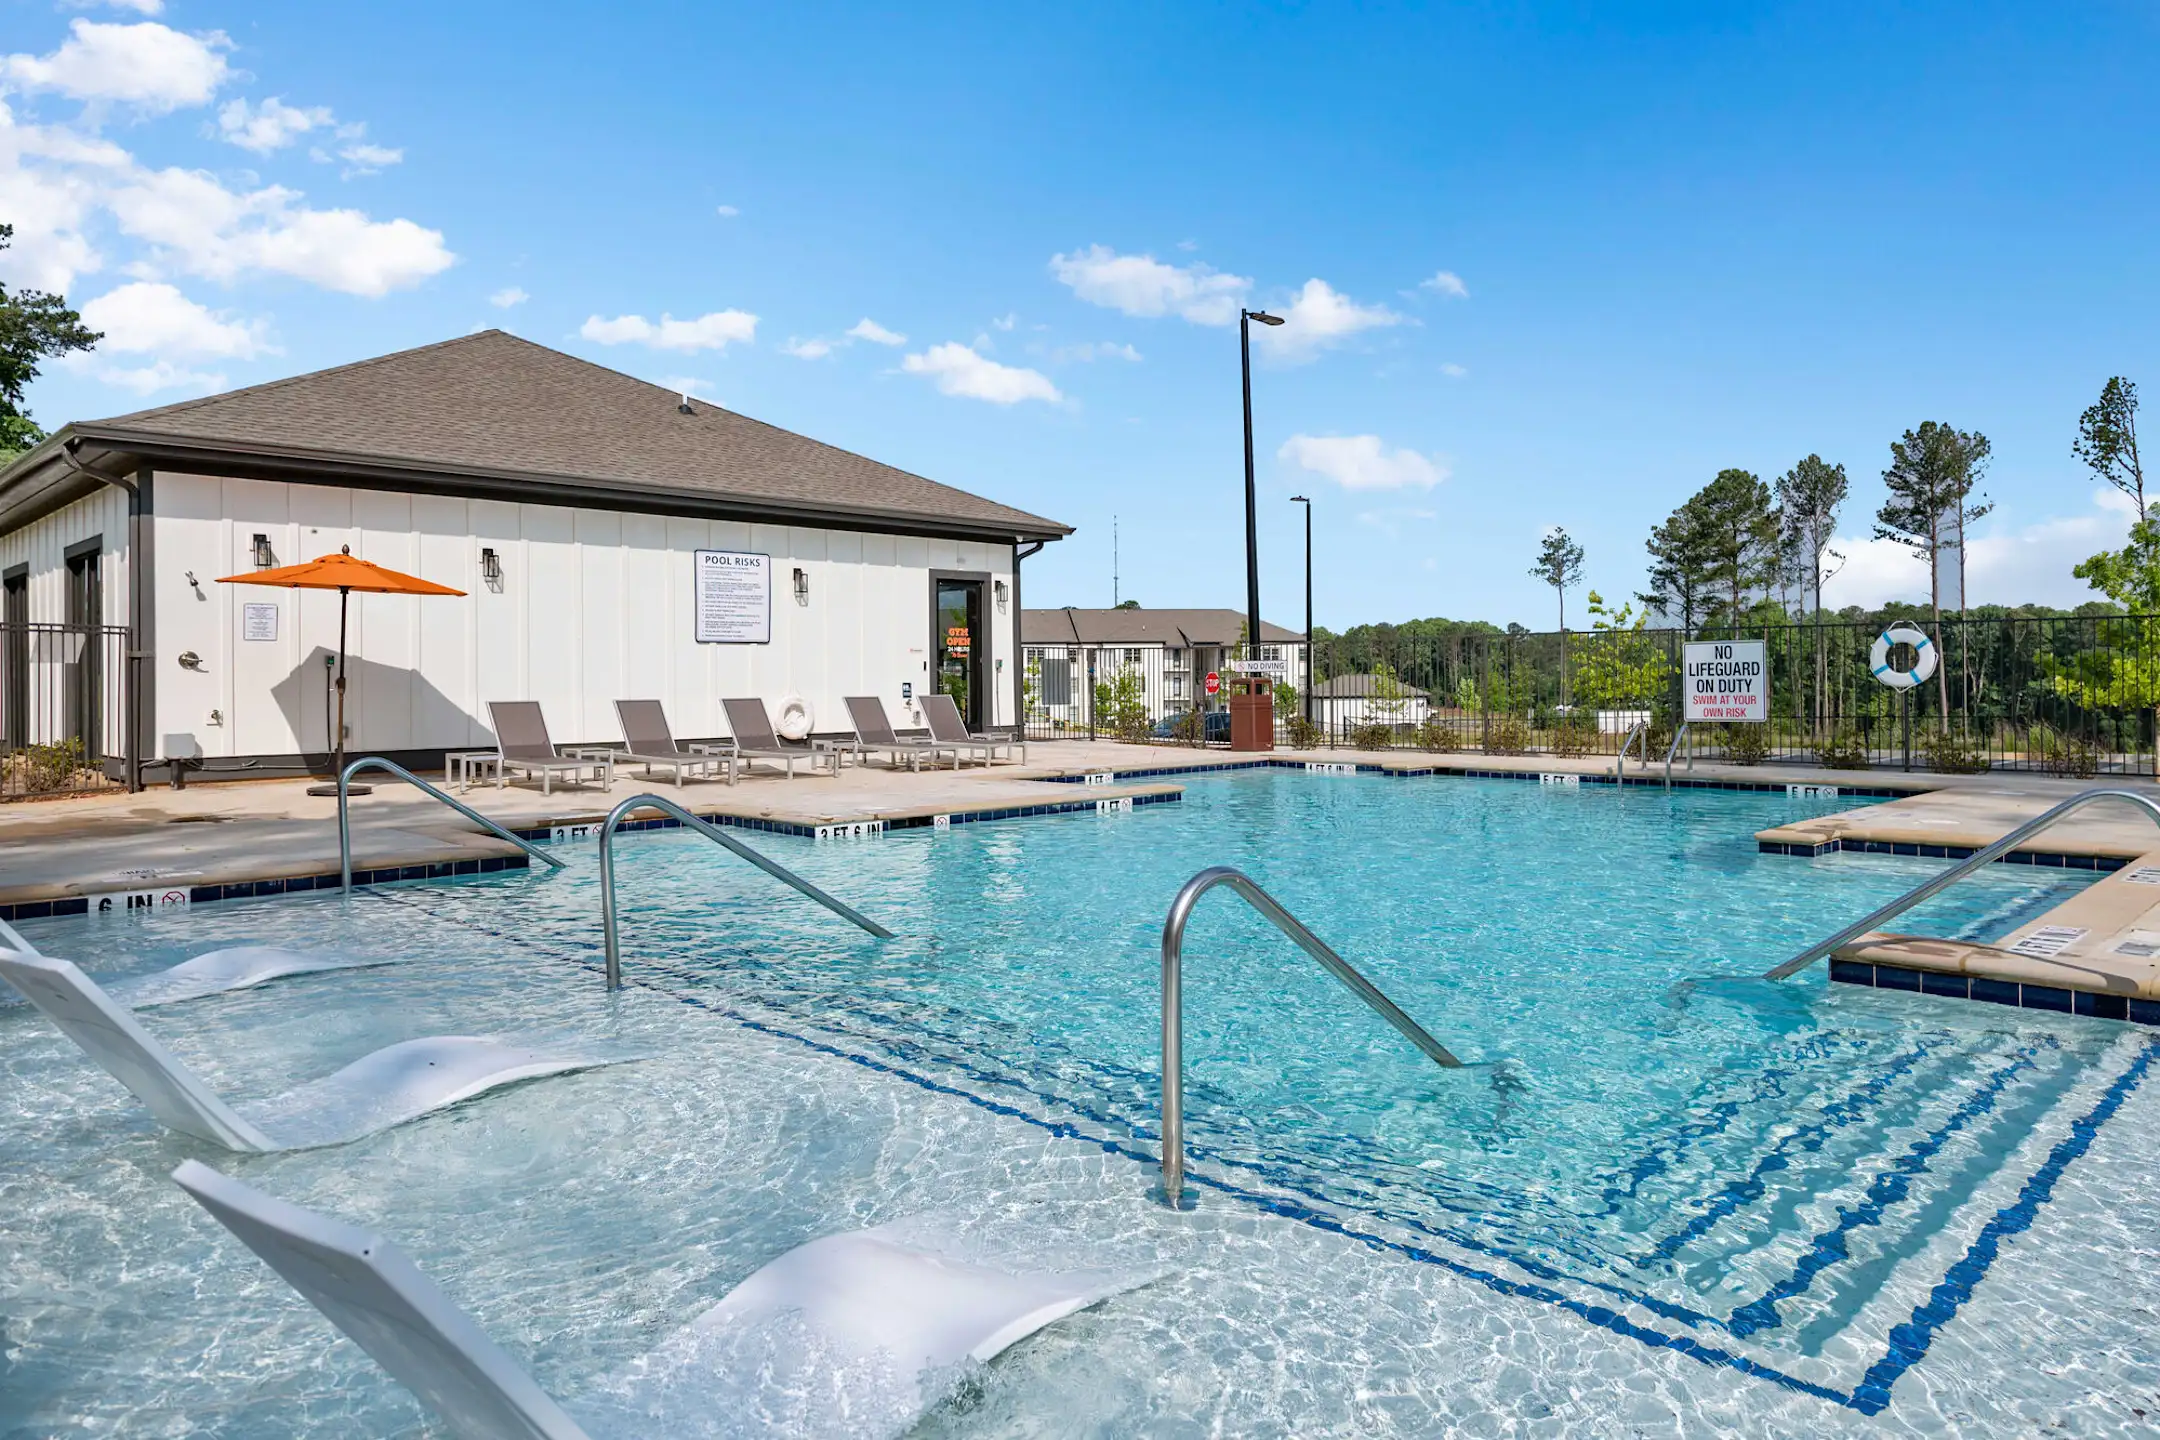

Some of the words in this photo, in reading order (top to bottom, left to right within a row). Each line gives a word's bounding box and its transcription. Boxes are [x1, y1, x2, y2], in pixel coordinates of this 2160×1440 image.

[705, 555, 731, 566] POOL
[735, 557, 760, 567] RISKS
[948, 627, 969, 636] GYM
[946, 636, 971, 646] OPEN
[1715, 645, 1732, 659] NO
[1247, 662, 1258, 670] NO
[1260, 662, 1284, 670] DIVING
[1689, 662, 1760, 676] LIFEGUARD
[1697, 679, 1713, 693] ON
[1719, 678, 1752, 693] DUTY
[1693, 695, 1717, 705] SWIM
[1720, 695, 1731, 705] AT
[1733, 695, 1757, 705] YOUR
[1703, 707, 1723, 717] OWN
[1726, 707, 1746, 717] RISK
[1805, 787, 1819, 795] FT
[572, 827, 588, 837] FT
[834, 826, 848, 837] FT
[867, 823, 880, 834] IN
[126, 894, 152, 910] IN
